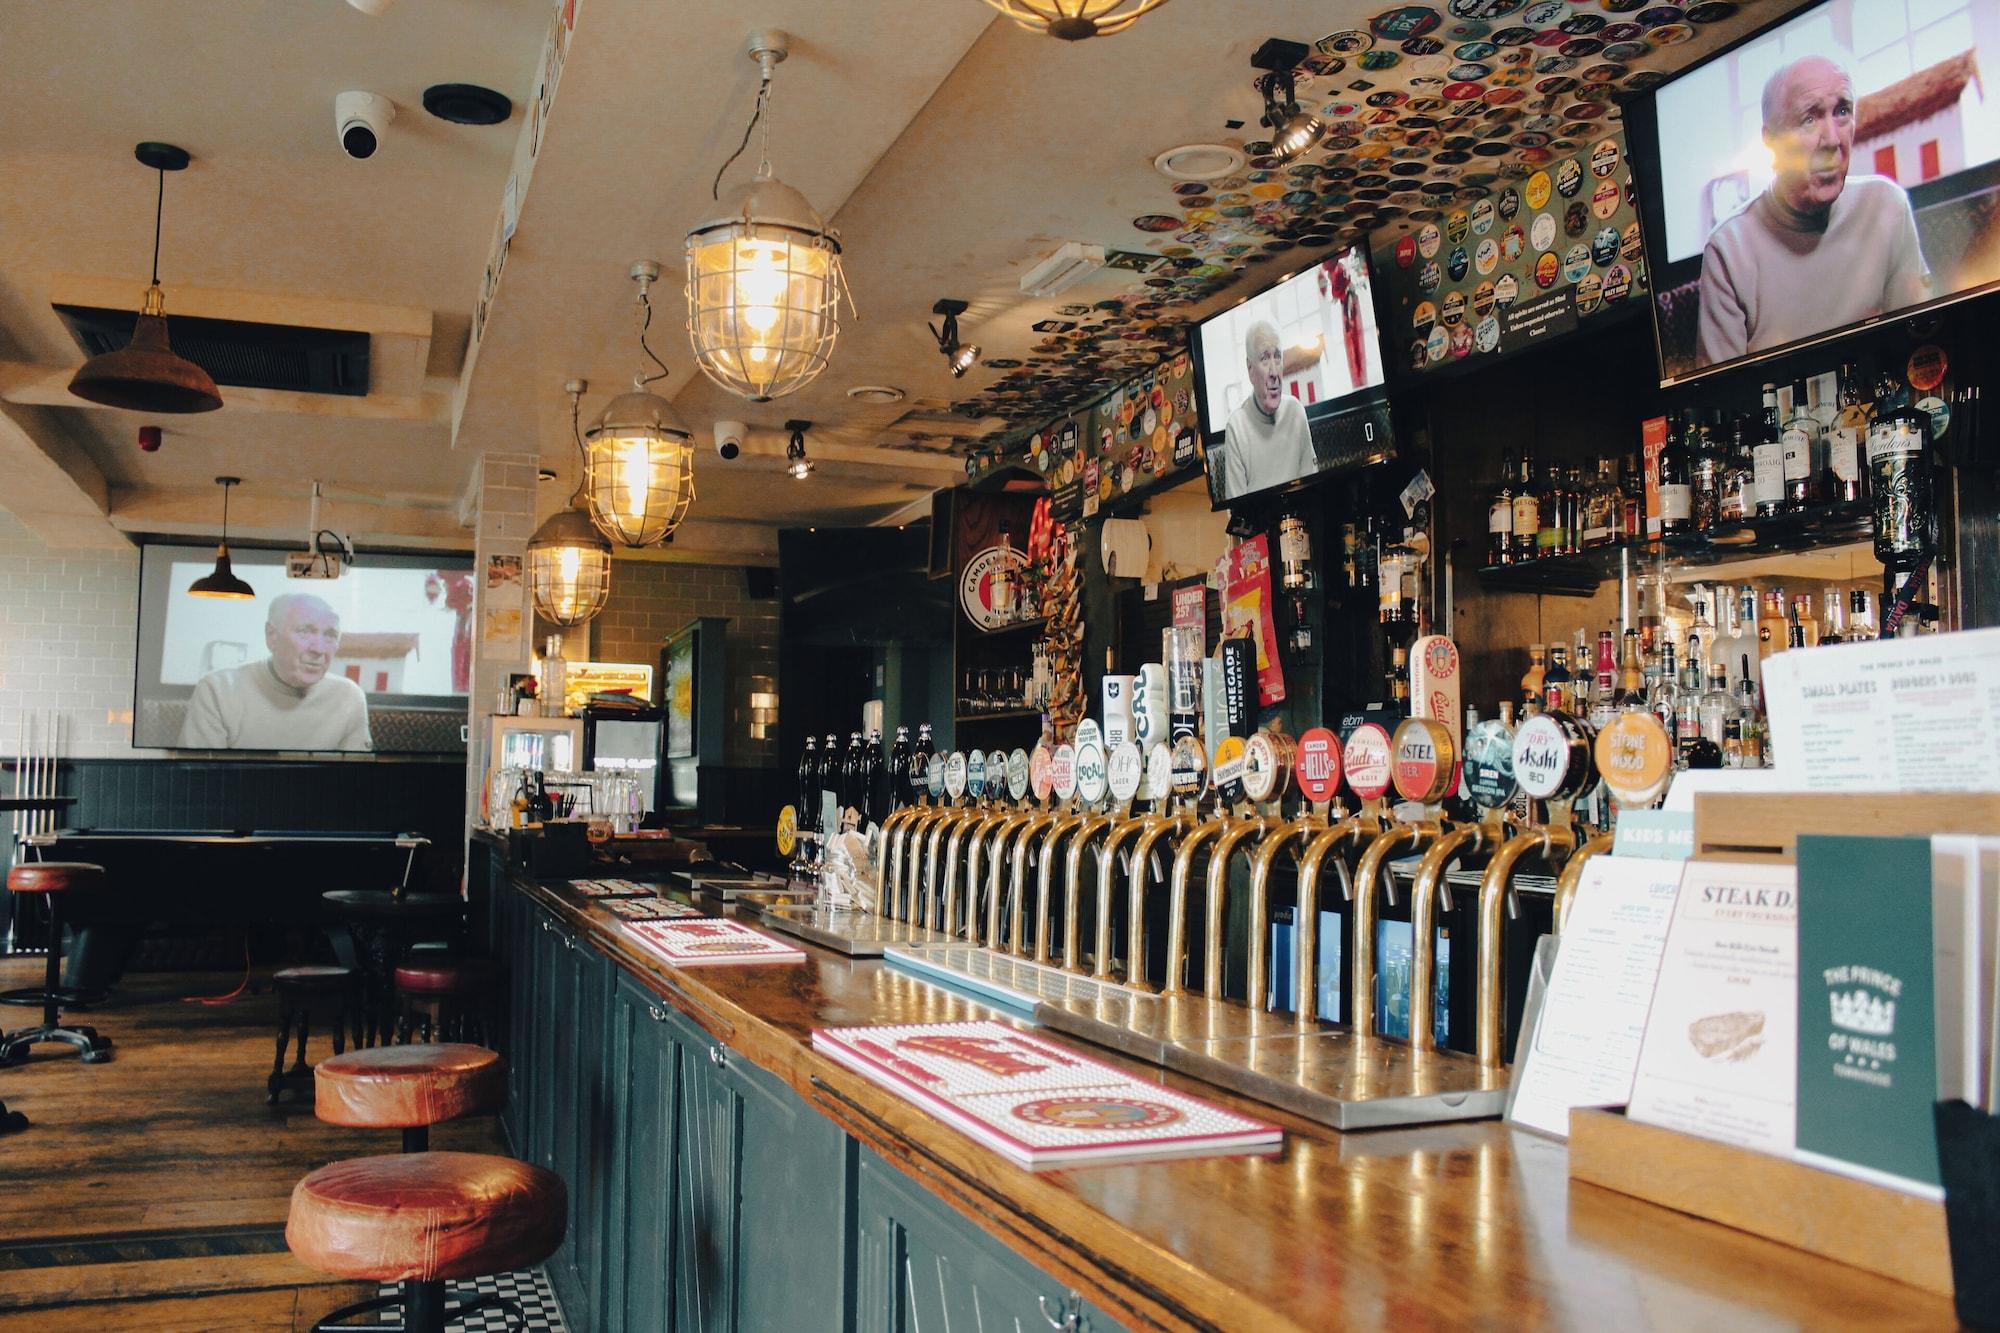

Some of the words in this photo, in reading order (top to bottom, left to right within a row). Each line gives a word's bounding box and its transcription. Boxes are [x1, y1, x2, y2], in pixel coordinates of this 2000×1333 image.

[1175, 590, 1204, 606] UNDER
[1226, 646, 1239, 724] RENEGADE
[1235, 661, 1244, 707] BREWERY
[1839, 681, 1877, 695] PLATES
[1342, 714, 1364, 726] ebm
[1306, 752, 1330, 780] HELLS
[1519, 745, 1558, 770] Asahi
[1112, 777, 1129, 785] LAGER
[1472, 784, 1496, 794] SESSION
[1622, 828, 1664, 843] KIDS
[1702, 886, 1771, 907] STEAK
[1823, 965, 1849, 986] THE
[1849, 965, 1902, 998] PRINCE
[1828, 1032, 1848, 1051] OF
[1848, 1035, 1897, 1061] WALES
